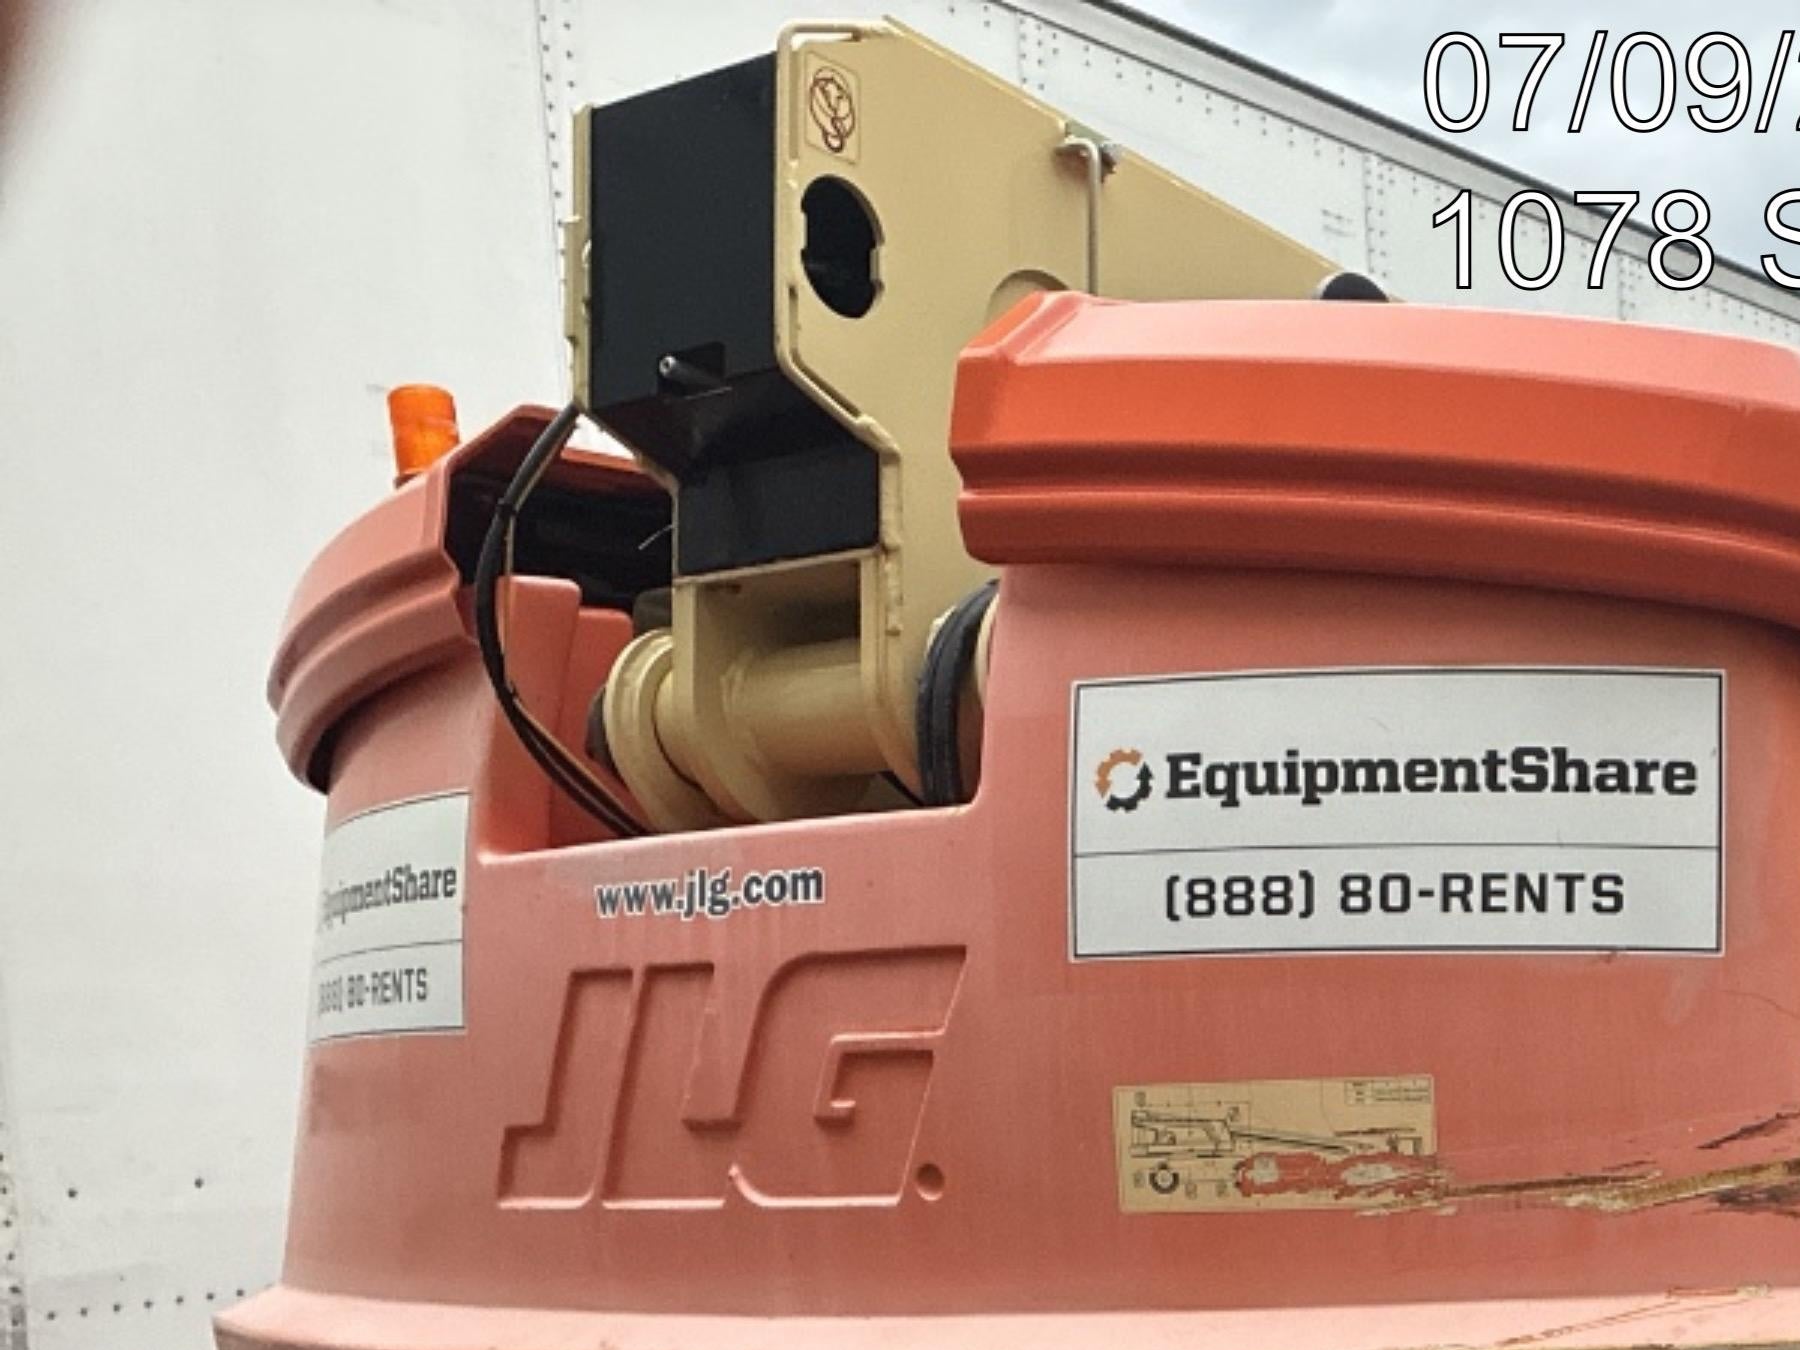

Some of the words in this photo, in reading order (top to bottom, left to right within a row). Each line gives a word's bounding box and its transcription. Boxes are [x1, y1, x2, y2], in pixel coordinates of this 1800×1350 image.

[1164, 746, 1698, 808] EquipmentShare
[596, 867, 824, 919] www.jlg.com
[1165, 869, 1316, 922] (888)
[1339, 872, 1625, 916] 80-RENTS
